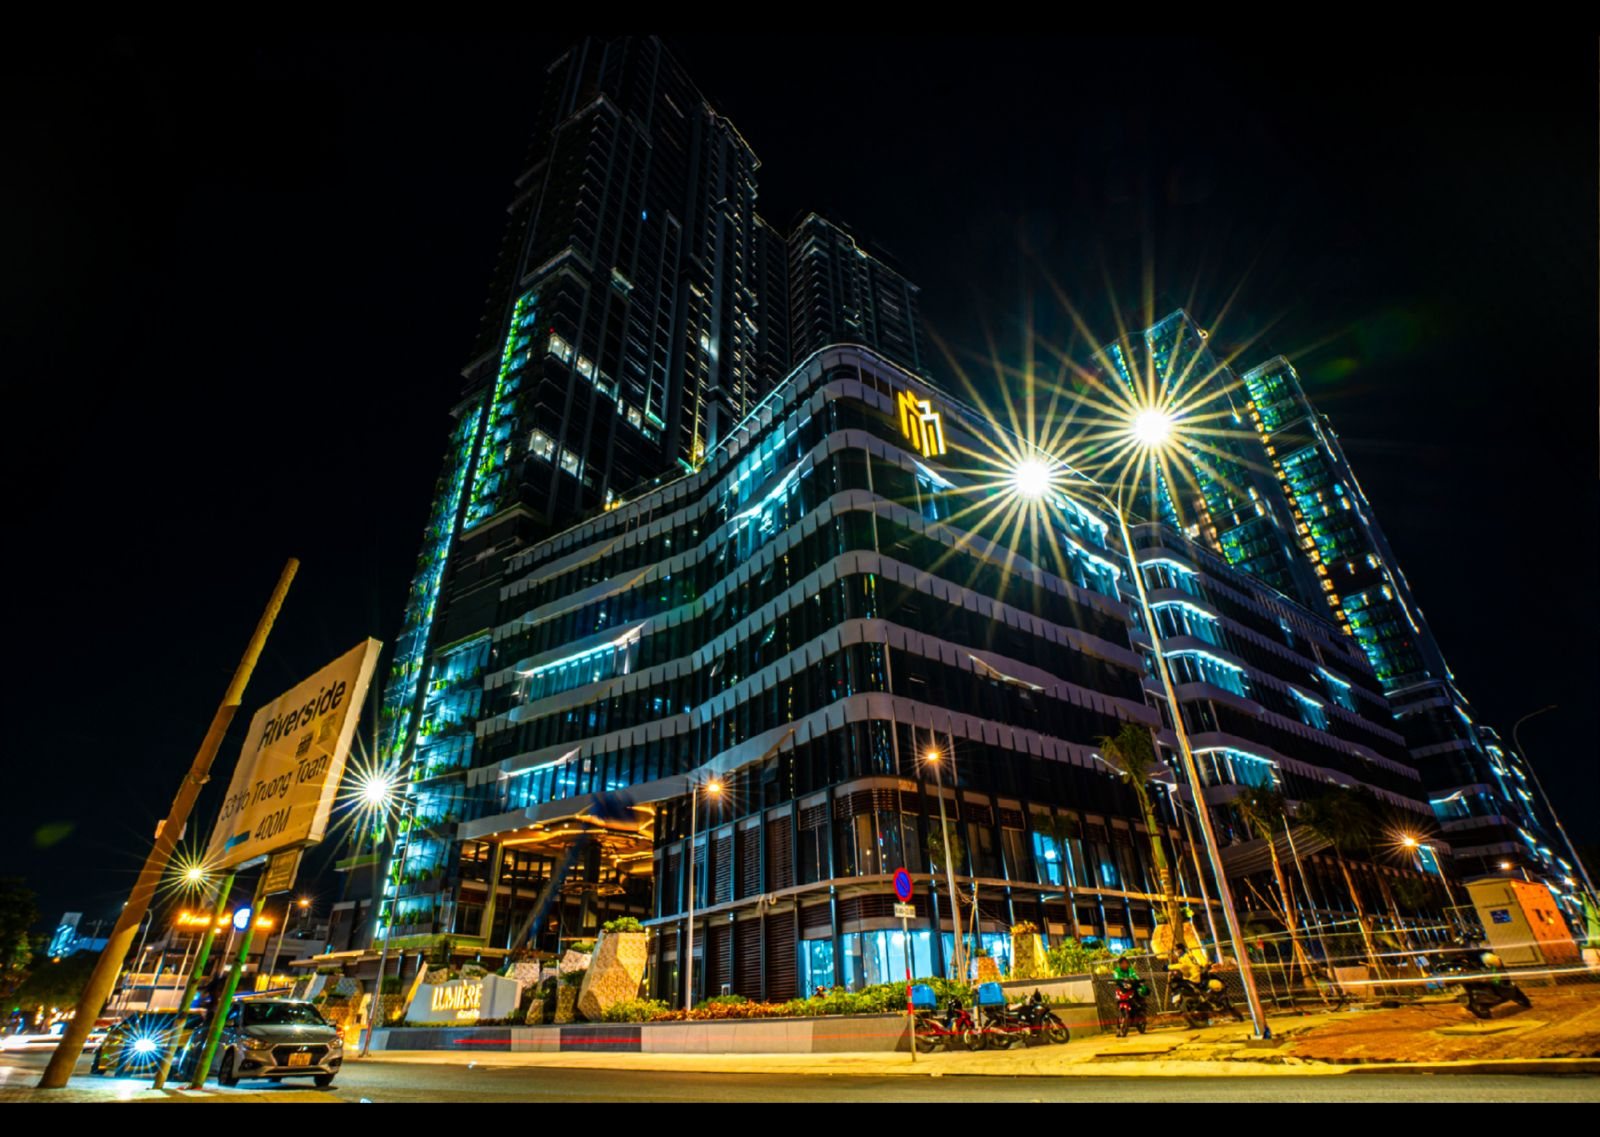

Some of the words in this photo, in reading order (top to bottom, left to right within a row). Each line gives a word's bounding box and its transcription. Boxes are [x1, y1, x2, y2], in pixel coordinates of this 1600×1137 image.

[257, 680, 346, 752] Riverside
[252, 772, 293, 806] Truong
[296, 754, 328, 785] Toan
[255, 806, 292, 841] 400M
[432, 979, 483, 1011] LUMIÈRE
